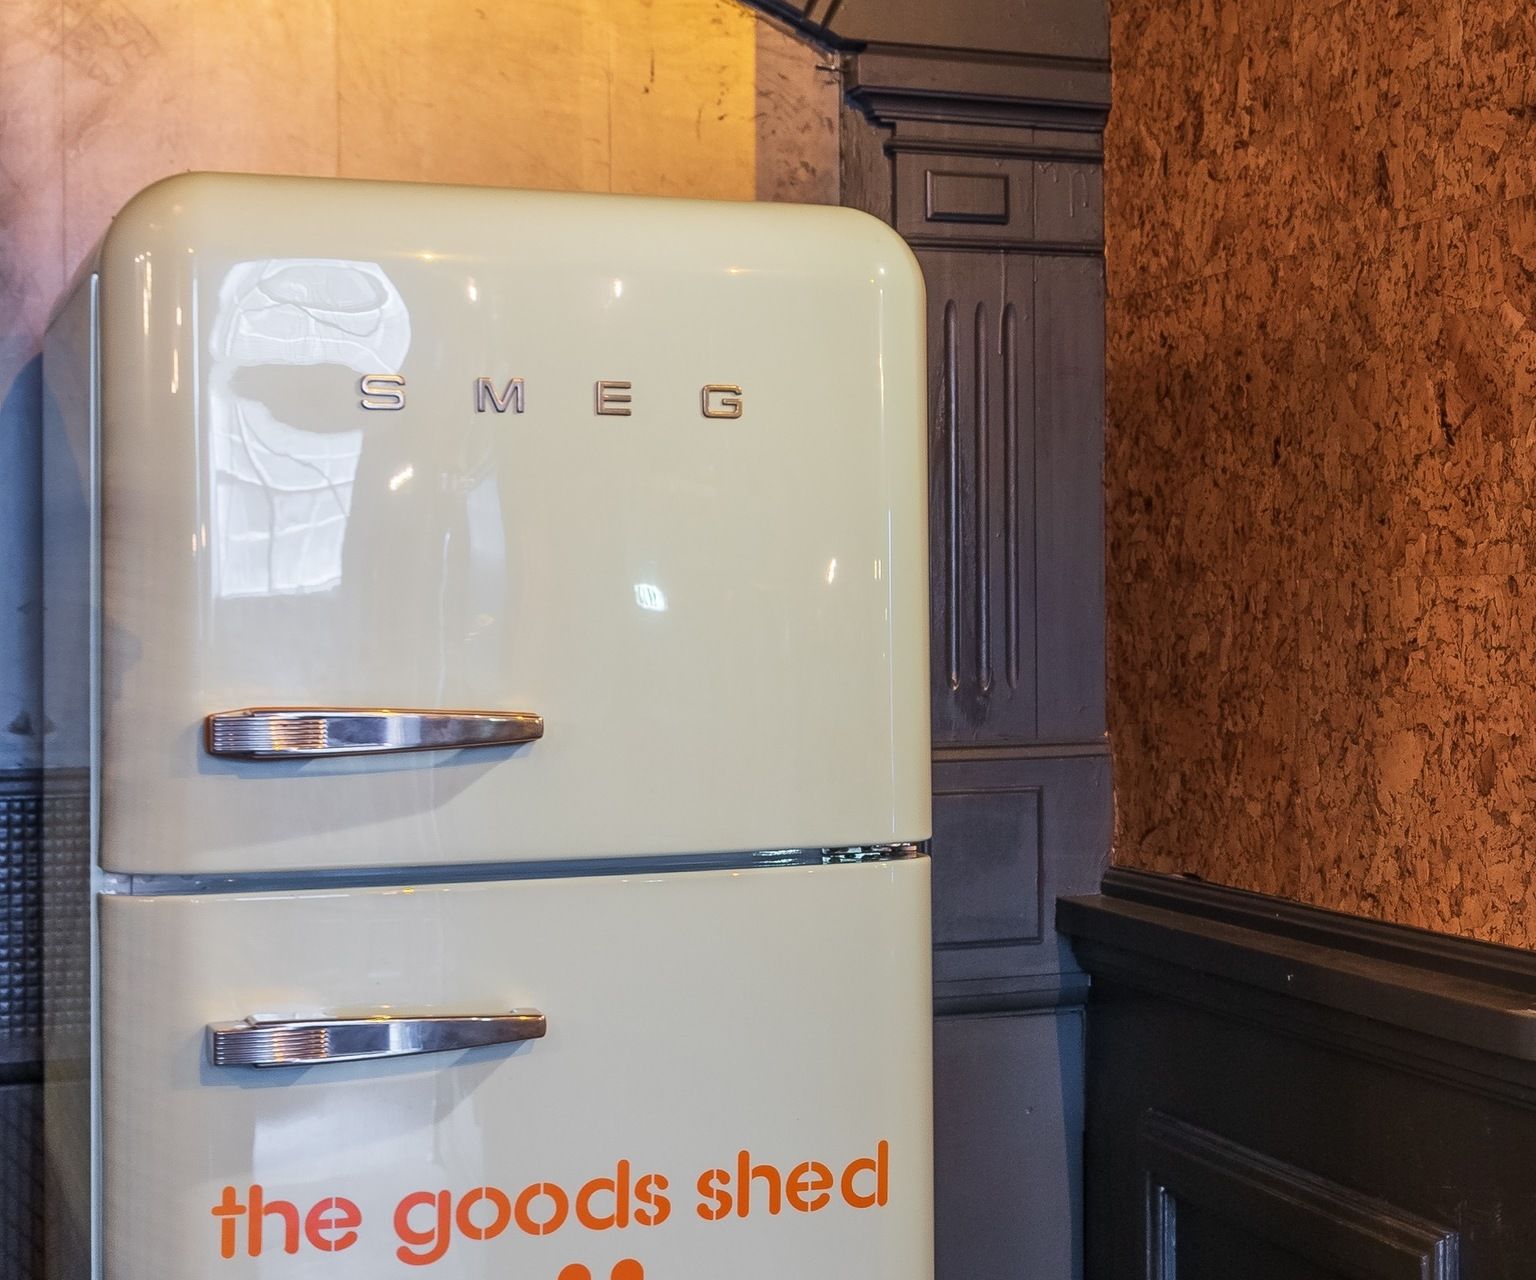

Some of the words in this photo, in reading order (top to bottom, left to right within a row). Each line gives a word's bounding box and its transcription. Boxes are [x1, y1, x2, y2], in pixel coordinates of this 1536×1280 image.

[360, 374, 743, 419] SMEG
[211, 1185, 362, 1258] the
[394, 1159, 671, 1266] goods
[696, 1140, 889, 1220] shed
